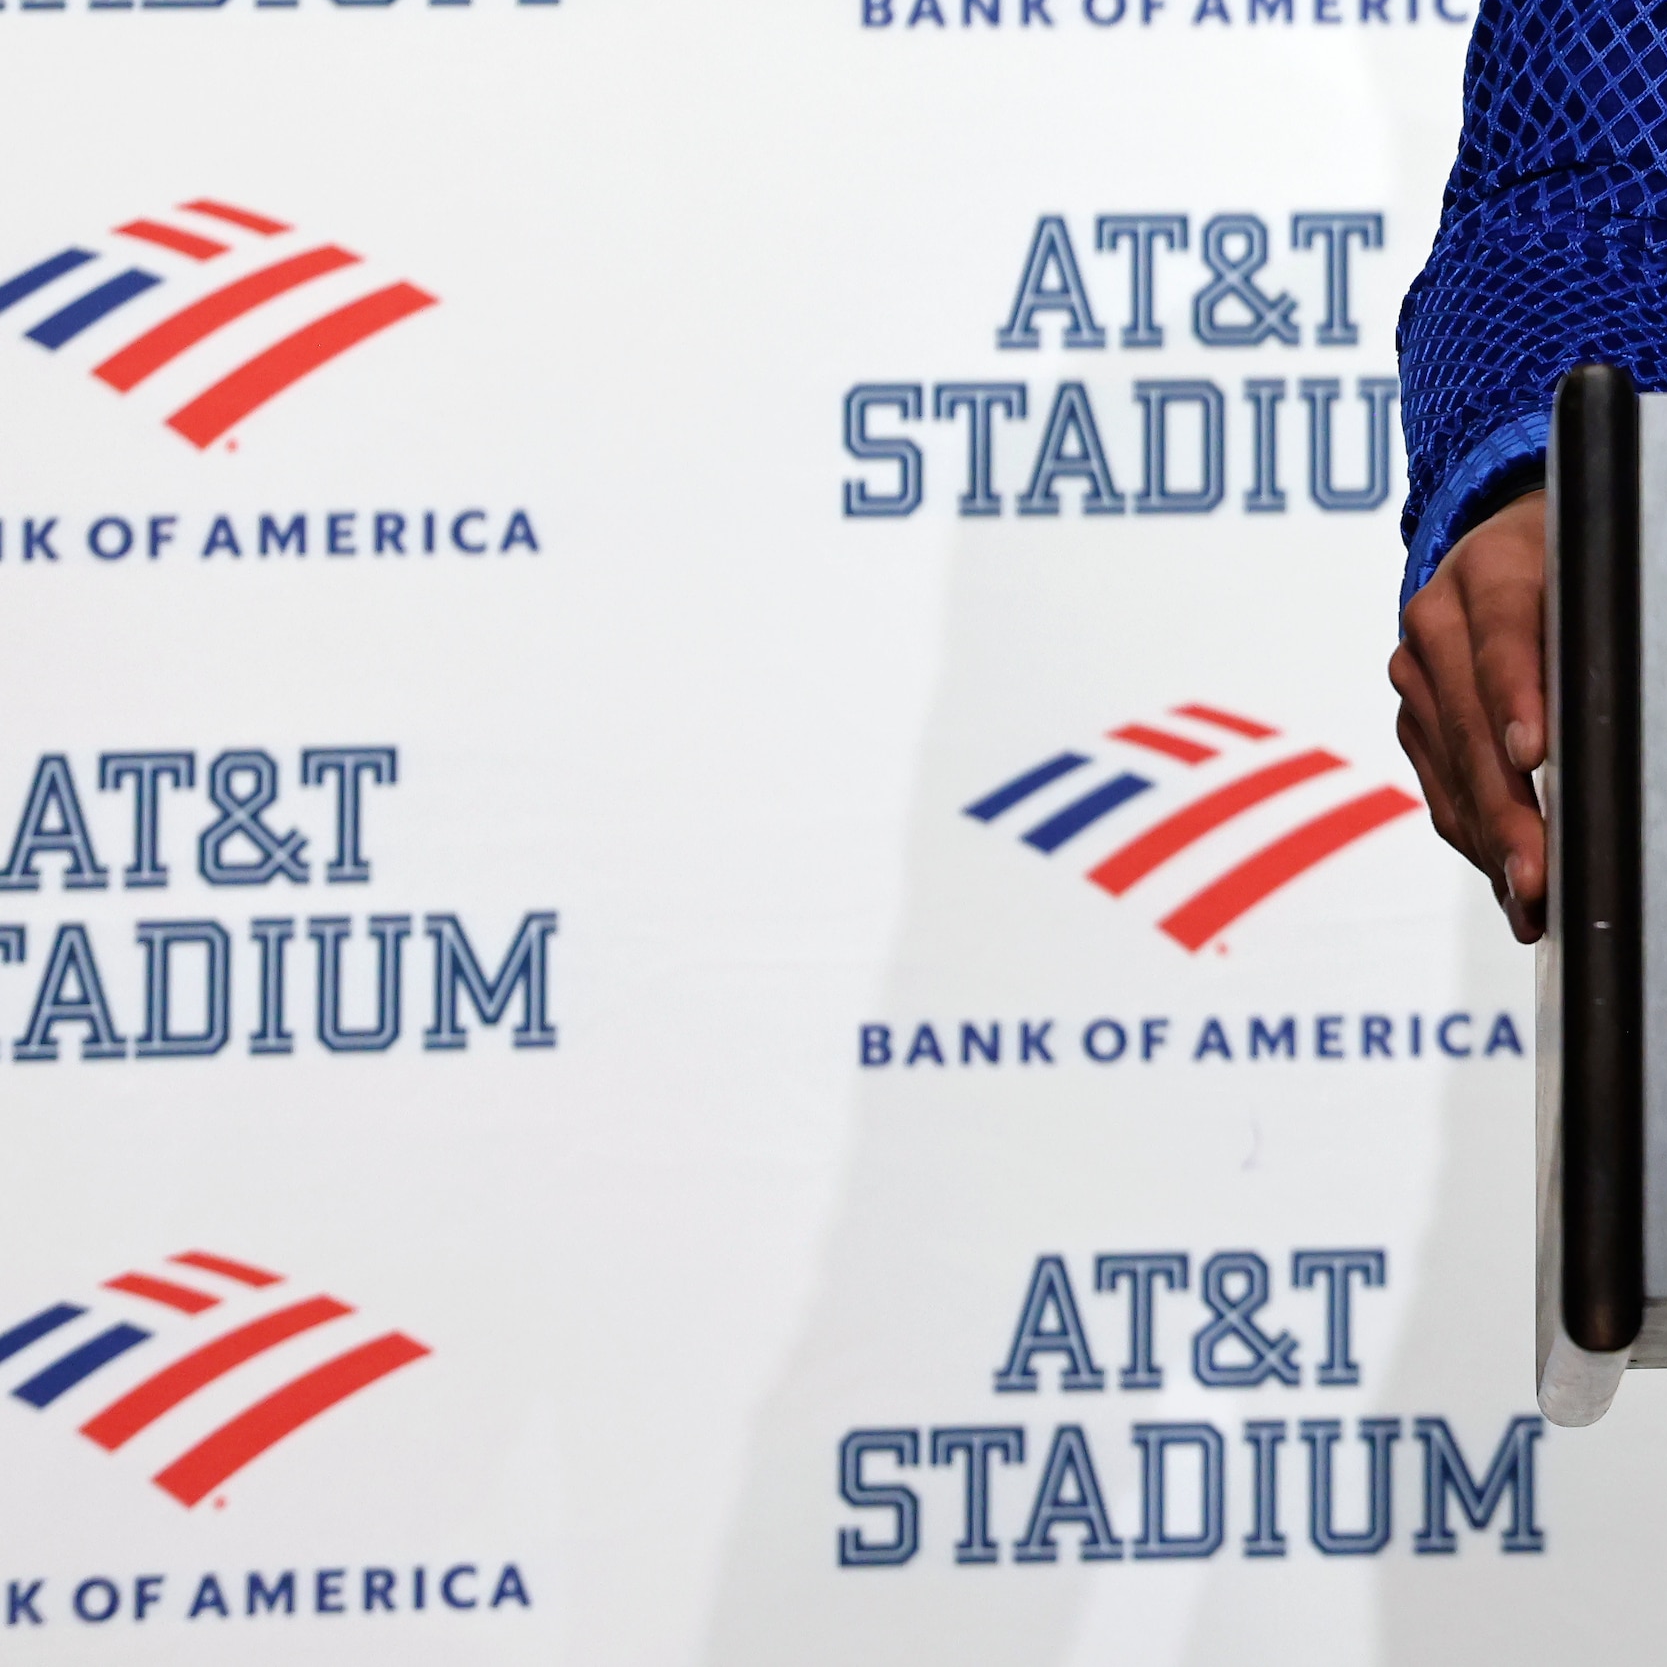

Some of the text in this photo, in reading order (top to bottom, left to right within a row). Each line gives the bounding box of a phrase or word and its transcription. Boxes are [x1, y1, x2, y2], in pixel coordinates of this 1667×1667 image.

[997, 212, 1384, 350] AT&T
[87, 516, 176, 561] OF
[202, 510, 538, 558] AMERICA
[0, 746, 398, 892] AT&T
[0, 912, 557, 1062] ADIUM
[860, 1013, 1524, 1067] BANK OF AMERICA
[994, 1249, 1386, 1394] AT&T
[837, 1416, 1546, 1568] STADIUM
[73, 1576, 163, 1623] OF
[188, 1564, 530, 1619] AMERICA
